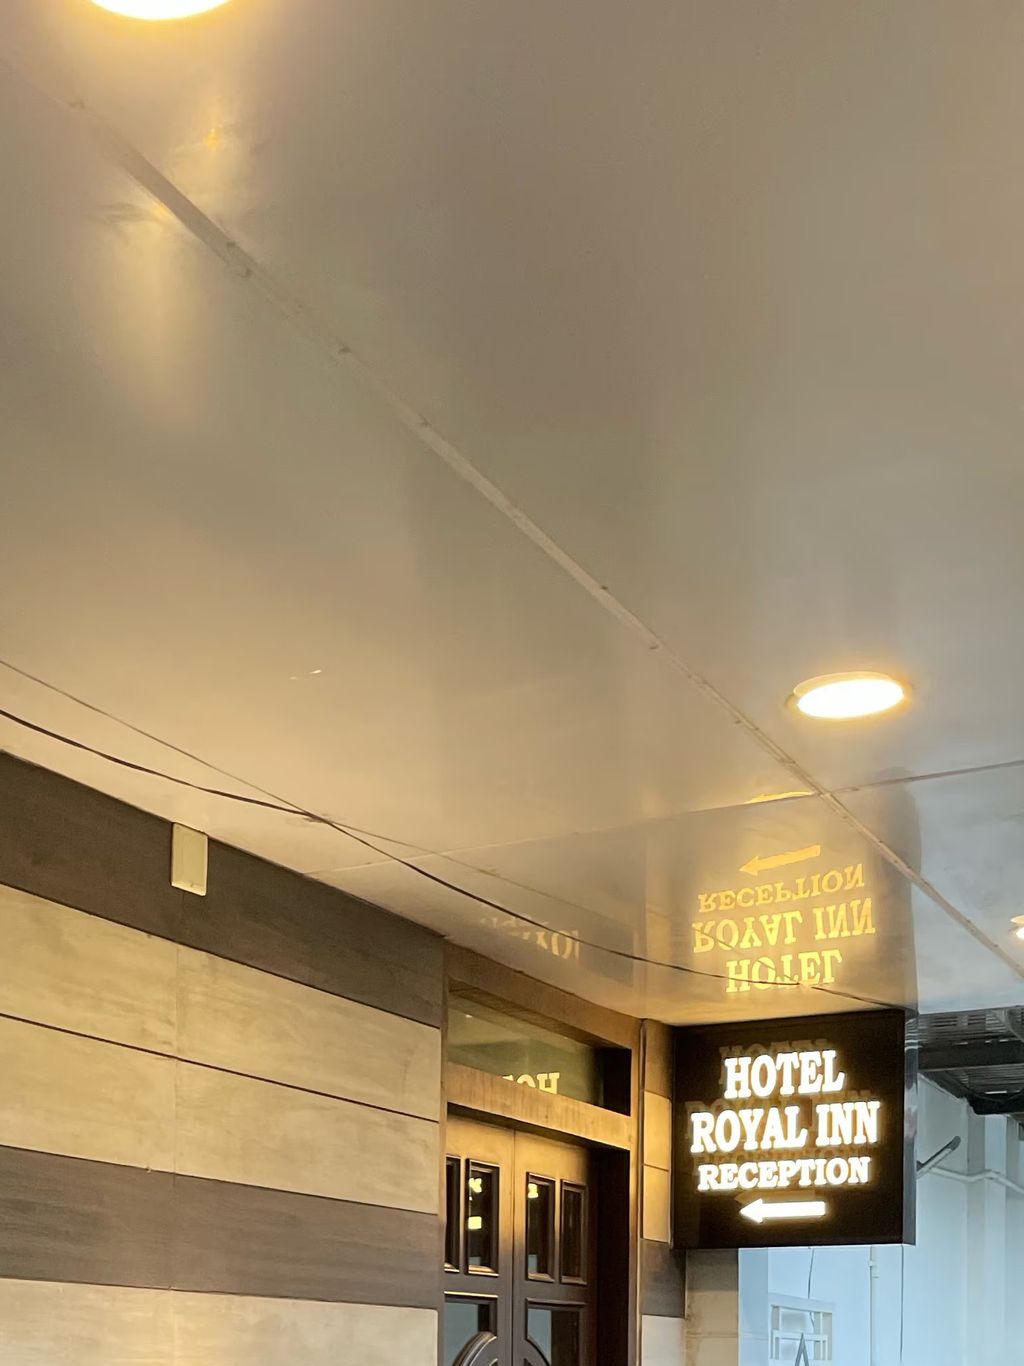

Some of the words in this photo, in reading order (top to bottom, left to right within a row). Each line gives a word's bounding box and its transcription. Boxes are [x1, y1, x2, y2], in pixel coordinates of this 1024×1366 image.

[723, 1049, 846, 1099] HOTEL
[690, 1105, 808, 1153] ROYAL
[815, 1101, 880, 1145] INN
[697, 1156, 871, 1191] RECEPTION
